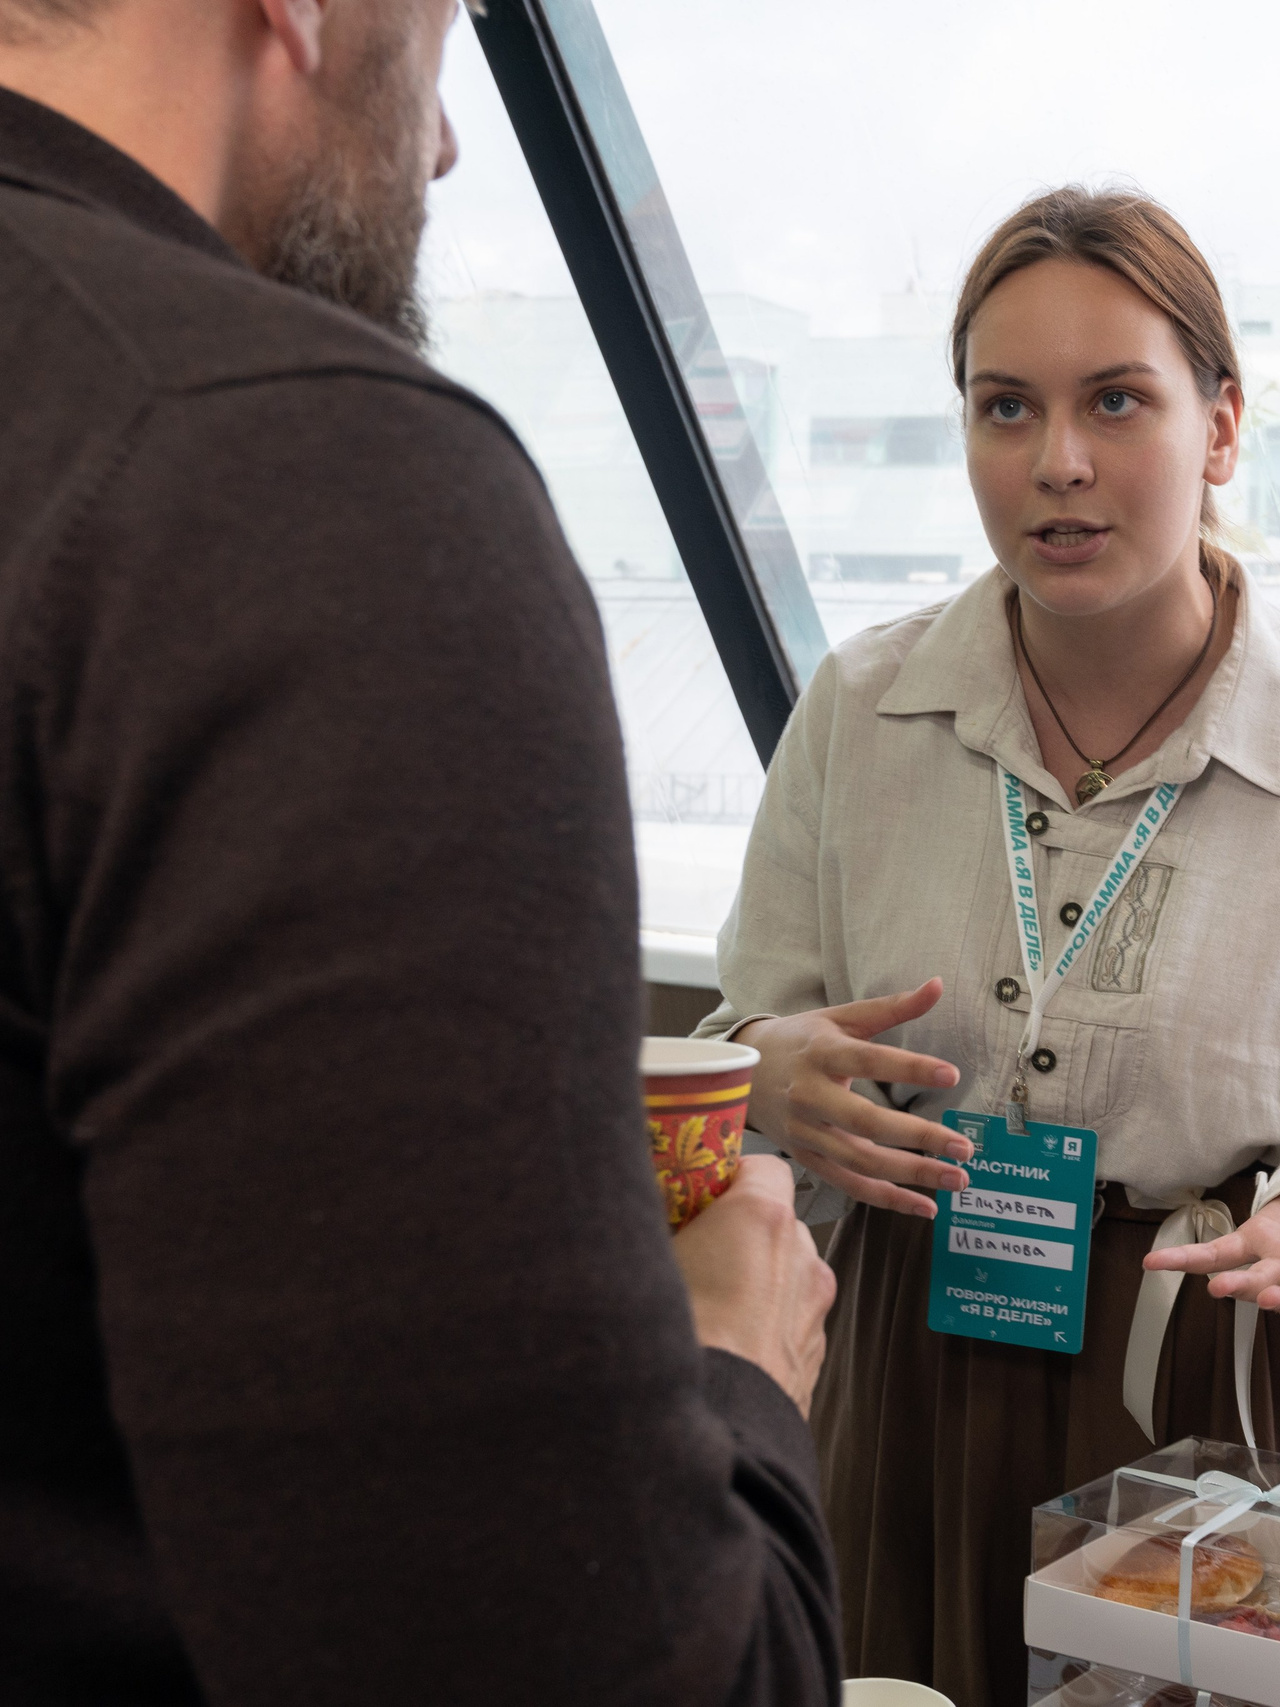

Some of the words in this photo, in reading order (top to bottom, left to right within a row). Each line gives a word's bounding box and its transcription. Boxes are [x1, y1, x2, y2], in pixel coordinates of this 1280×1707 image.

[1015, 856, 1031, 881] «Я
[1018, 885, 1033, 899] В
[1056, 851, 1136, 976] ПРОГРАММА
[1133, 822, 1150, 850] «Я
[1145, 807, 1160, 824] В
[1018, 902, 1042, 972] ДЕЛЕ»
[955, 1229, 1046, 1258] Иванова
[945, 1286, 1009, 1308] ГОВОРЮ
[1009, 1296, 1069, 1316] ЖИЗНИ
[960, 1303, 982, 1317] «Я
[983, 1308, 995, 1318] В
[996, 1309, 1052, 1328] ДЕЛЕ»
